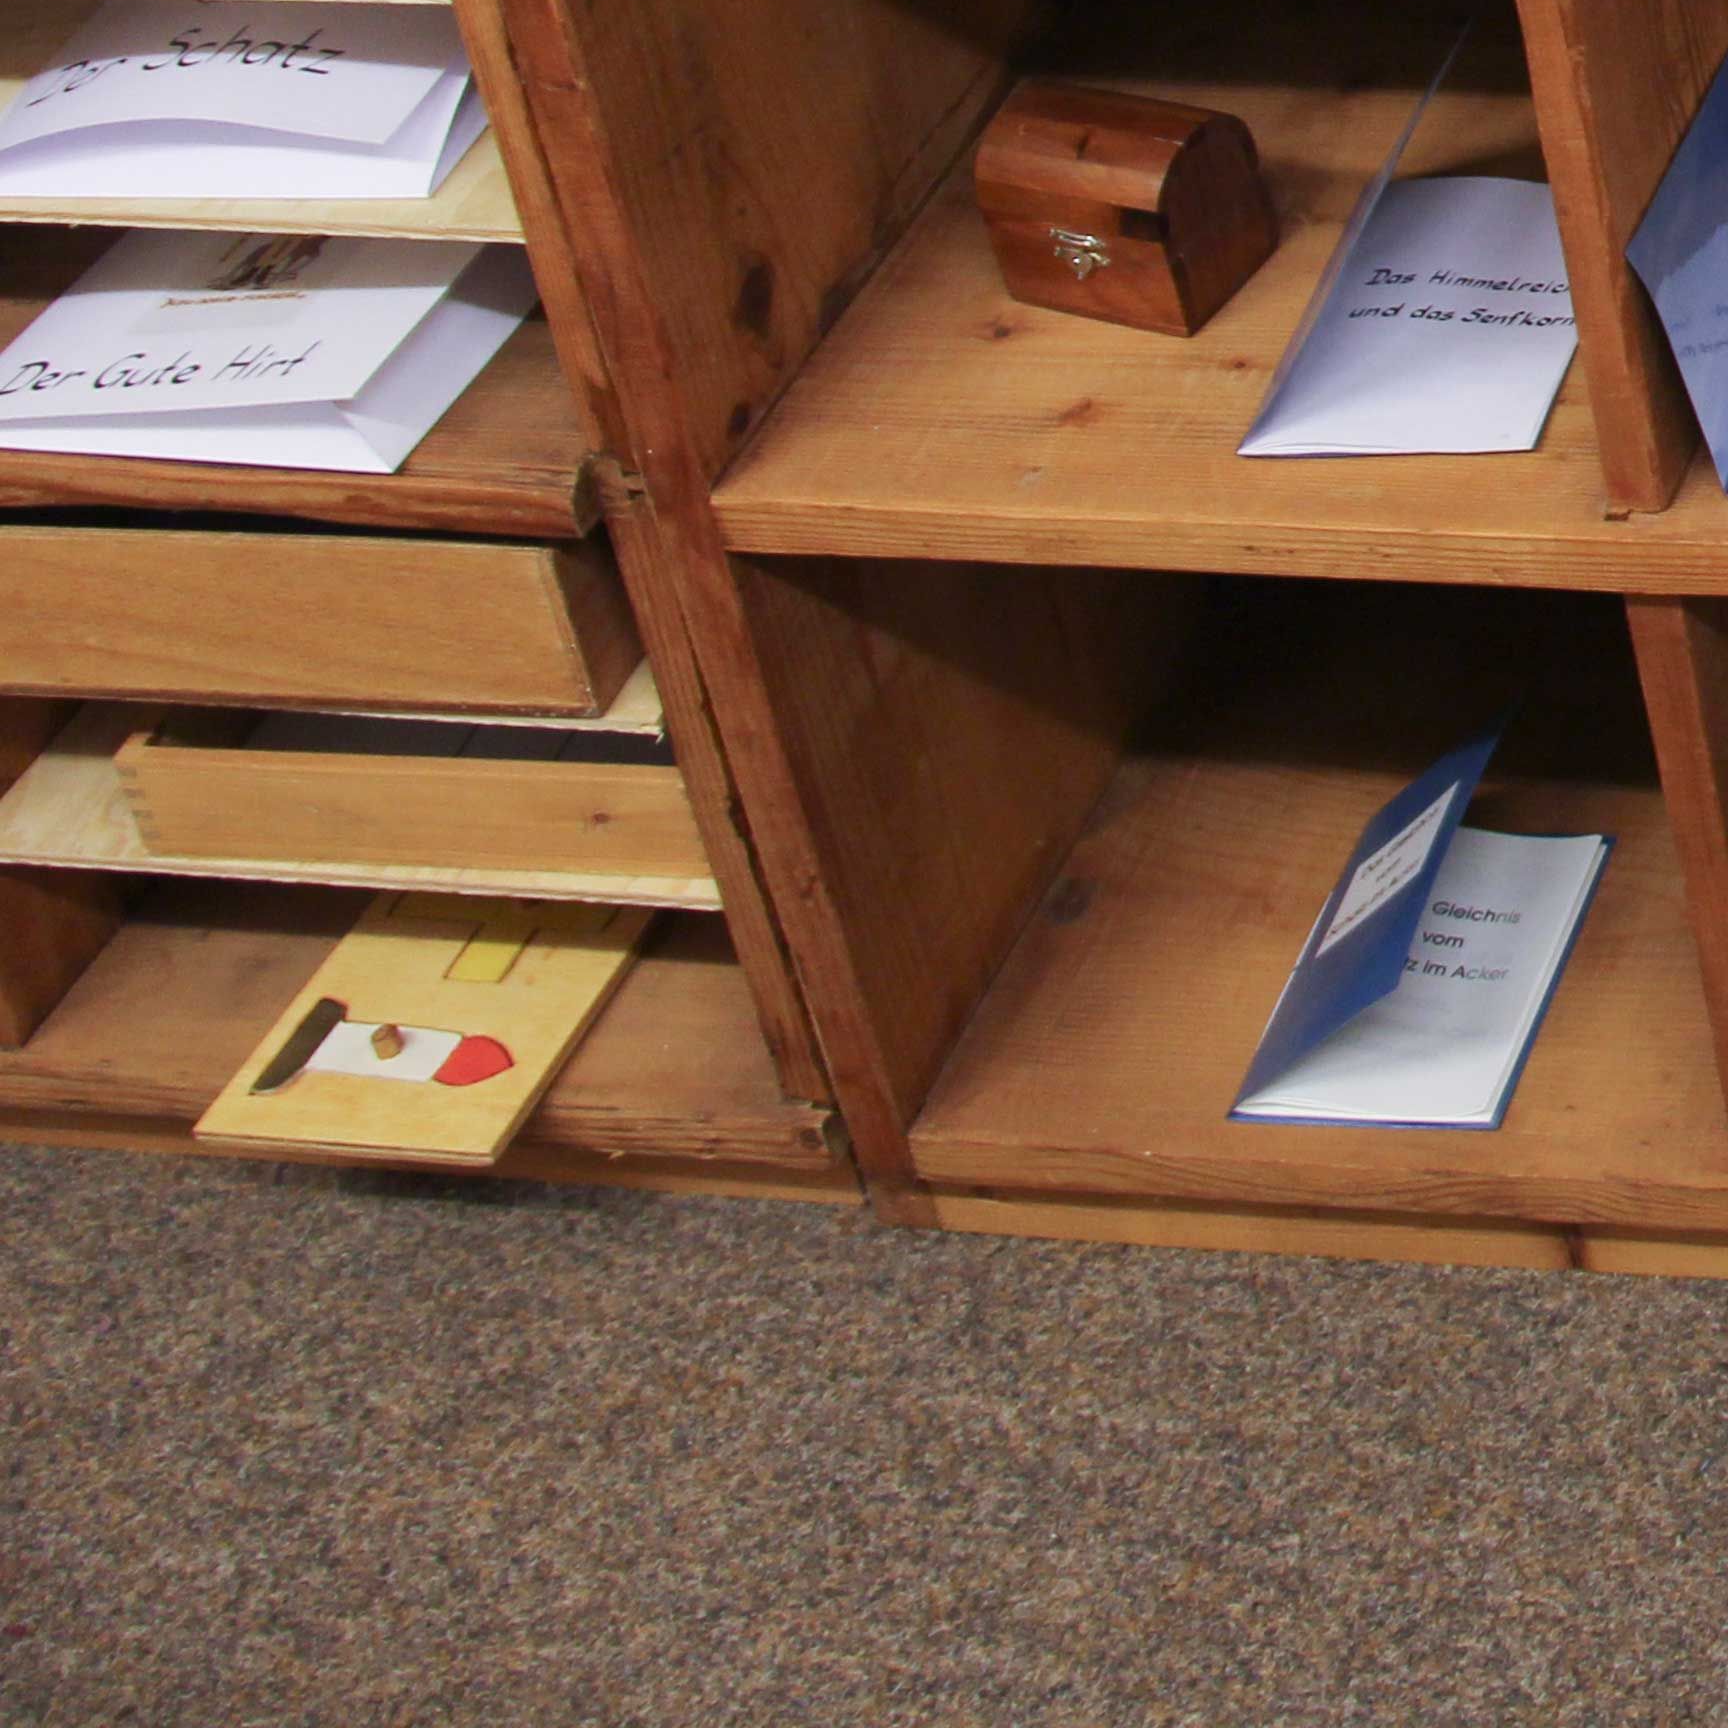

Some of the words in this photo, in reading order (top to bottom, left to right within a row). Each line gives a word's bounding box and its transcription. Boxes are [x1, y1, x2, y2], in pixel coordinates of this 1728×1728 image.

[141, 24, 347, 75] Schatz
[1364, 268, 1416, 287] Das
[1427, 270, 1570, 295] Himmelreic
[1348, 302, 1406, 319] und
[1408, 305, 1455, 322] das
[0, 360, 86, 396] Der
[93, 351, 203, 390] Gute
[210, 339, 324, 383] Hirt
[1431, 900, 1522, 925] Gleichnis
[1421, 930, 1465, 949] vom
[1450, 964, 1510, 982] Acker
